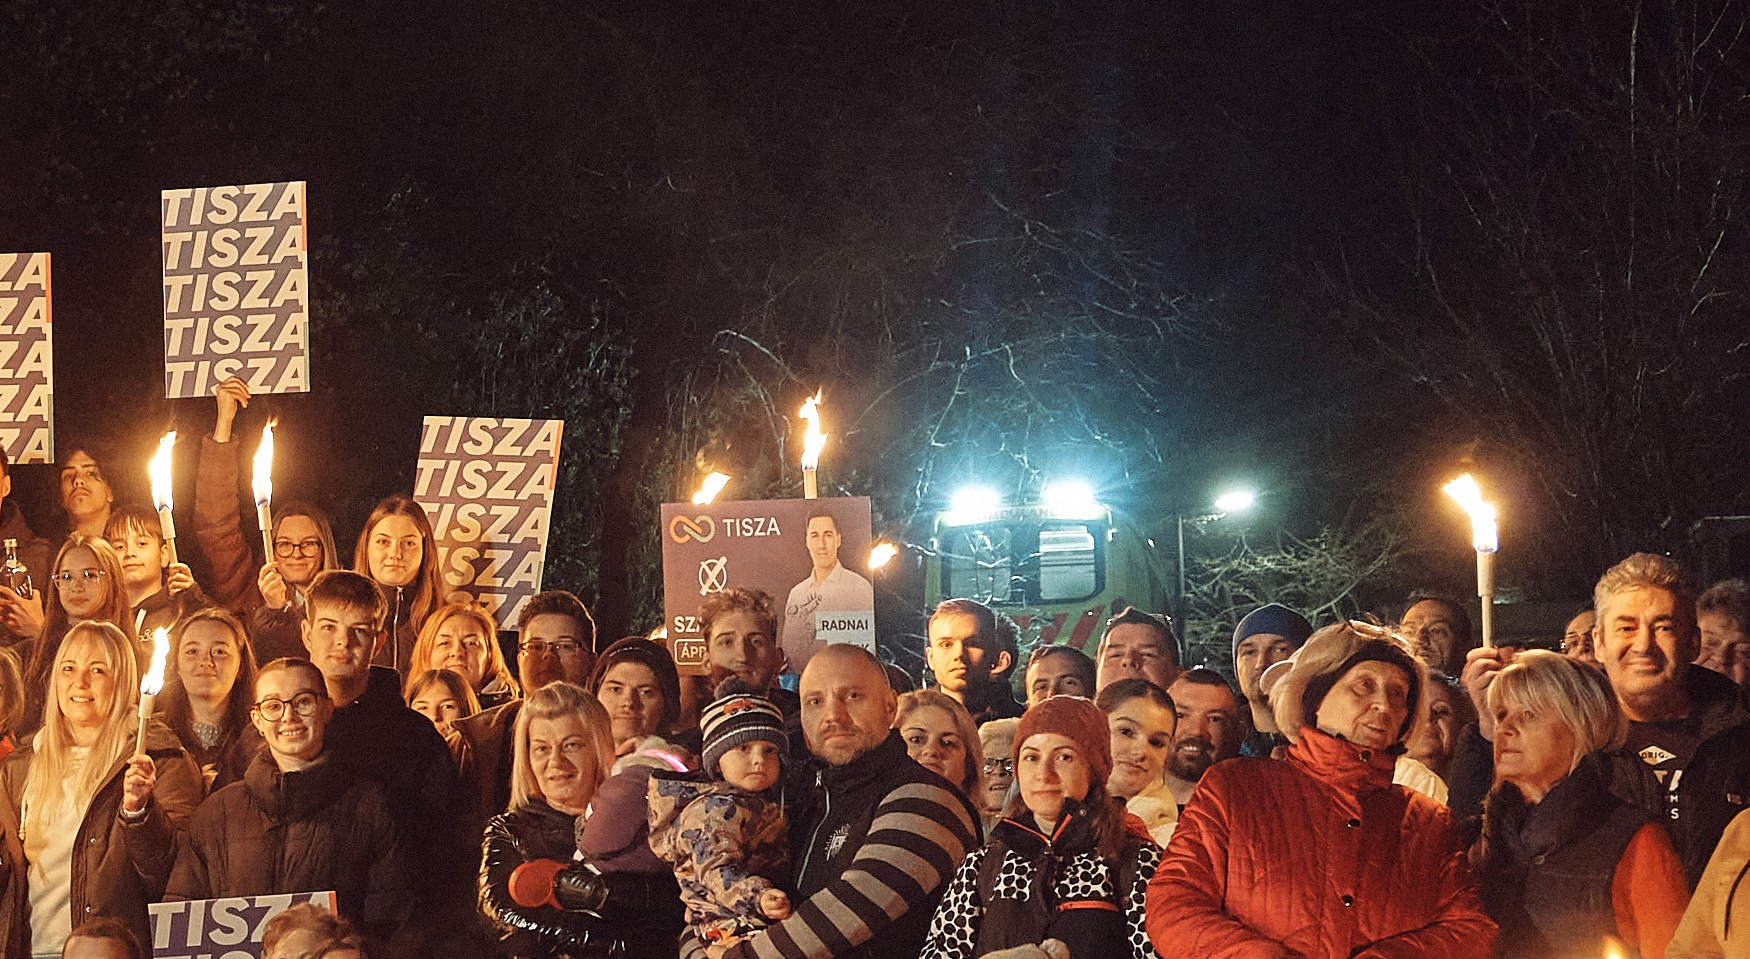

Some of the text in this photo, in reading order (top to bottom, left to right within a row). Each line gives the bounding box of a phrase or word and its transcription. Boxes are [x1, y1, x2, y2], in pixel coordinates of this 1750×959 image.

[162, 181, 302, 226] TISZA
[163, 225, 303, 270] TISZA
[164, 269, 303, 313] TISZA
[165, 312, 304, 356] TISZA
[420, 416, 560, 457] TISZA
[414, 459, 554, 500] TISZA
[723, 518, 781, 537] TISZA
[821, 619, 869, 631] RADNAI
